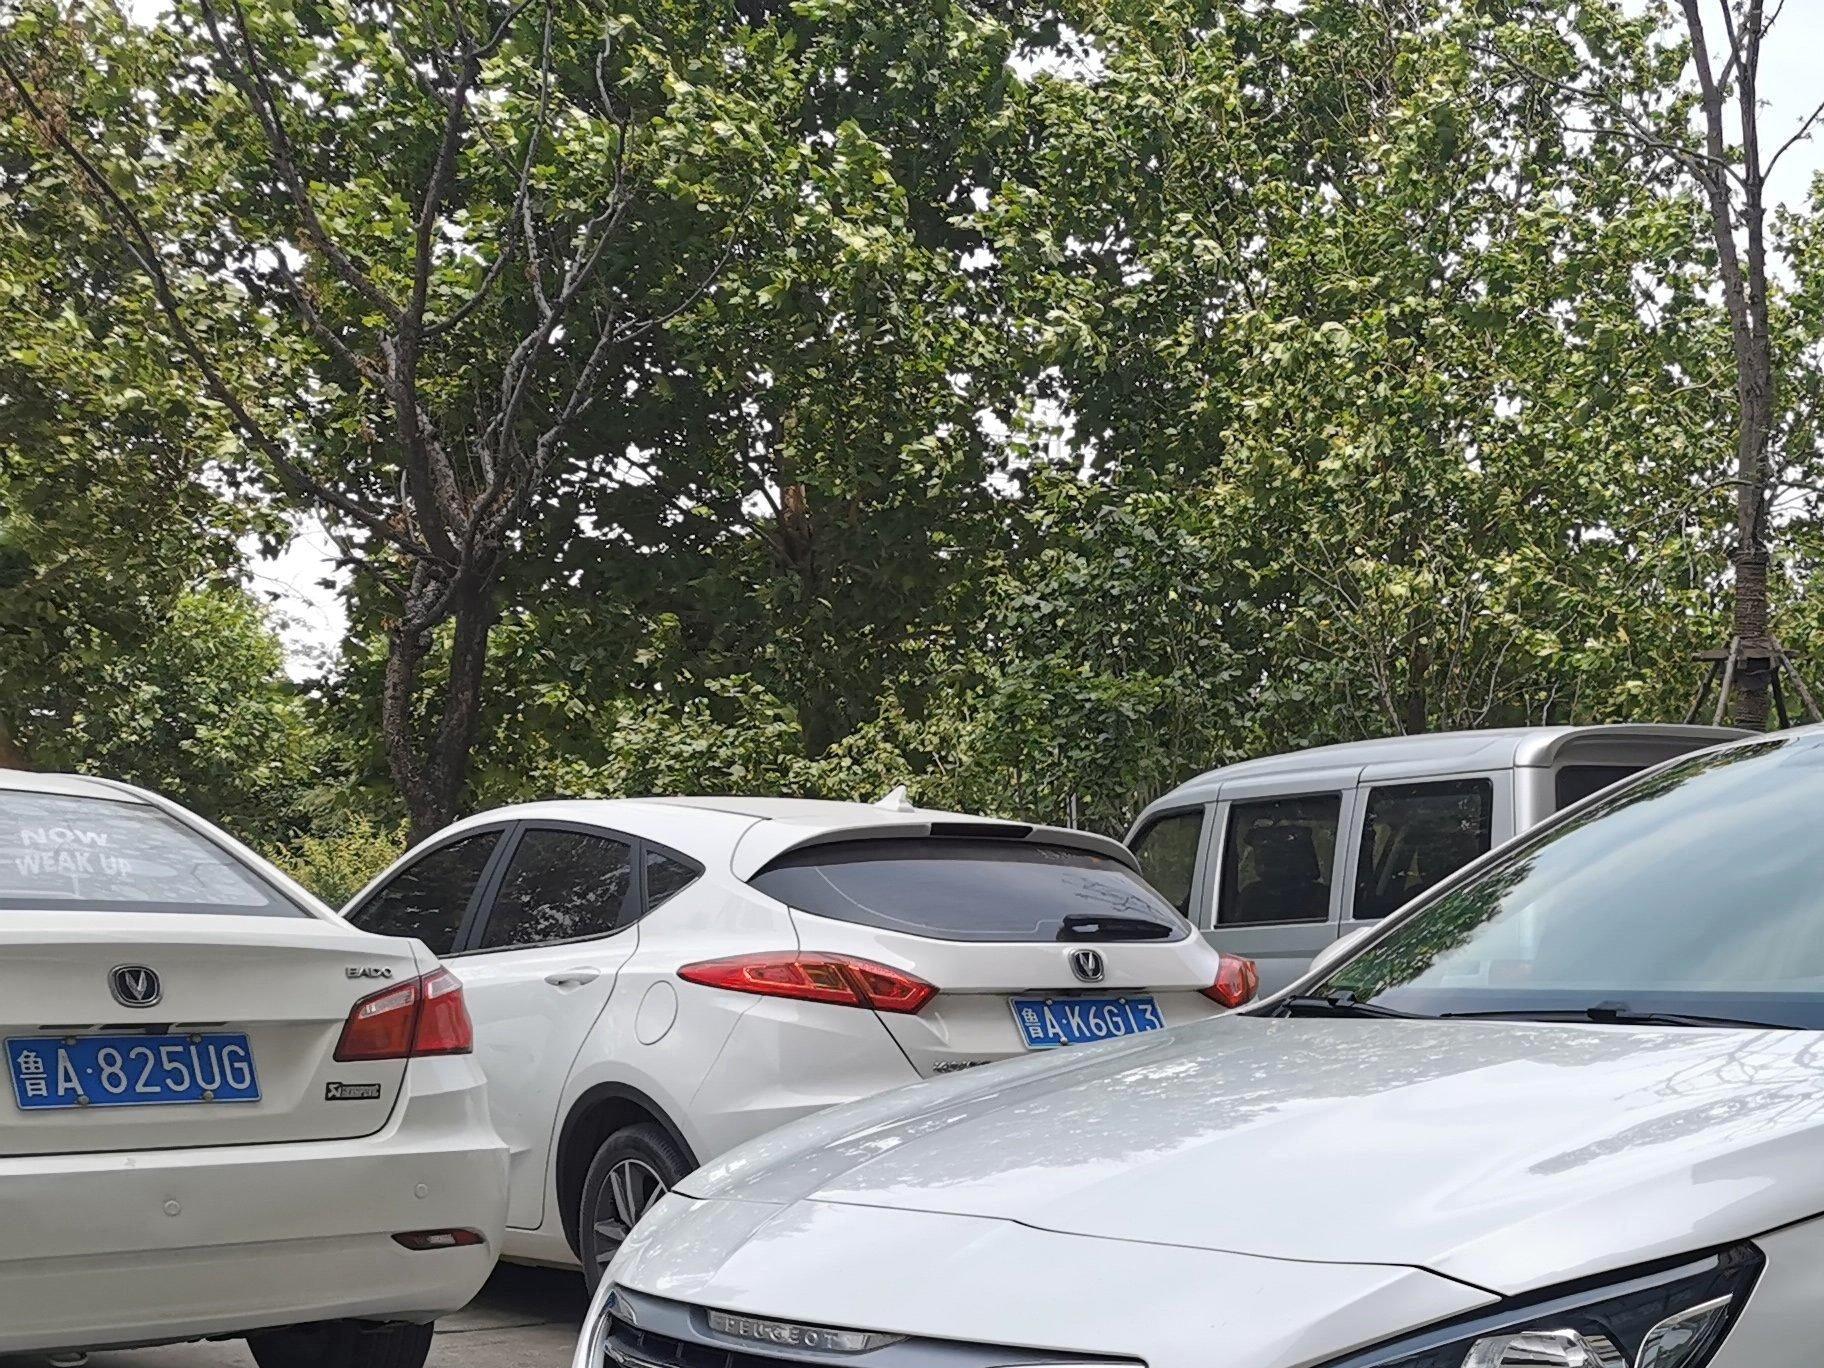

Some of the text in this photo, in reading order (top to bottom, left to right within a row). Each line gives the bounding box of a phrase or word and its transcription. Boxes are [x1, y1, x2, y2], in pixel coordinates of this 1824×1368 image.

[20, 827, 108, 846] NOW
[17, 1044, 252, 1098] 鲁A·825UG
[724, 1317, 839, 1349] PEUGEOT
